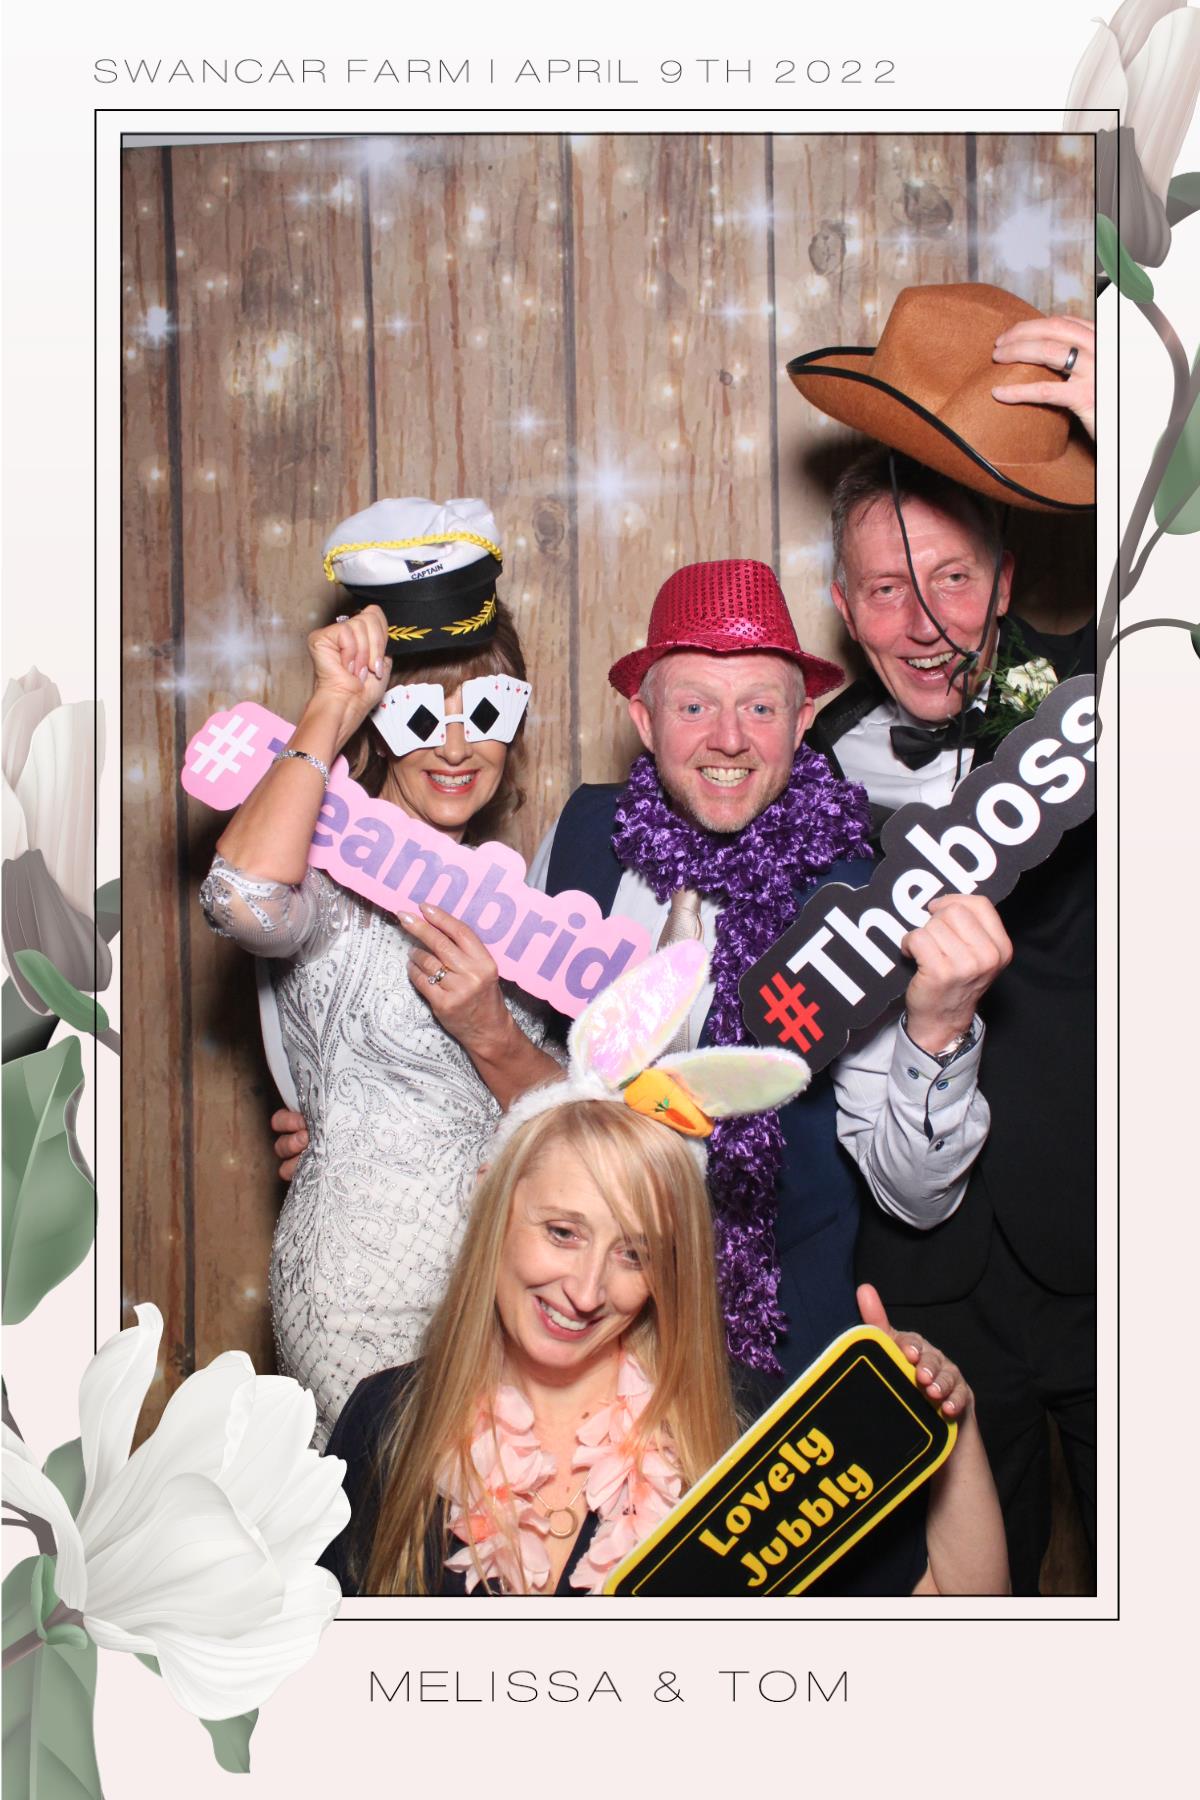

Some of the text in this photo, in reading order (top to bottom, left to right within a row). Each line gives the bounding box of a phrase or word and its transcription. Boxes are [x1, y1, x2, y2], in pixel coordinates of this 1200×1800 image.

[411, 563, 444, 580] CAPTAIN
[191, 714, 637, 1004] #eambrid
[698, 1427, 835, 1557] Lovely
[740, 1463, 874, 1587] Jubbly
